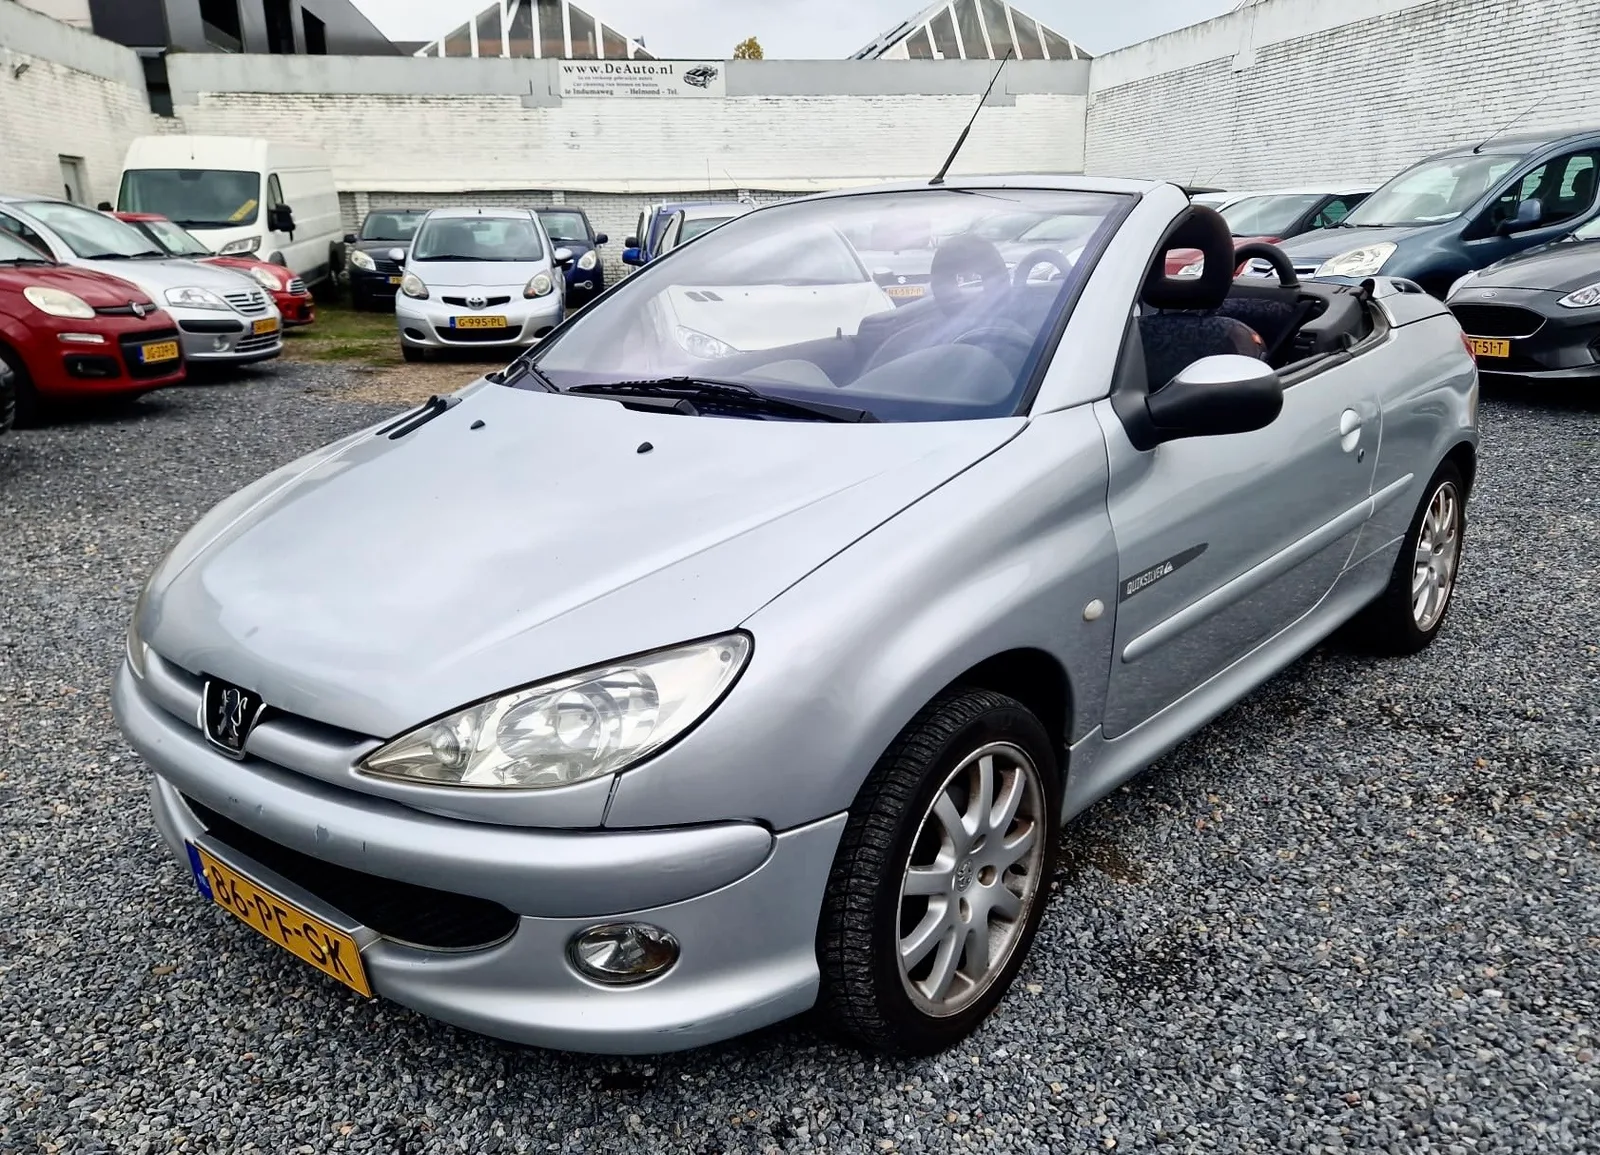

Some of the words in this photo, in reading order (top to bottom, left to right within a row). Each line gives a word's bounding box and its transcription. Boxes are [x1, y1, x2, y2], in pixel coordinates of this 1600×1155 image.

[563, 63, 674, 75] www.DeAuto.nl
[458, 318, 503, 327] G-995-PL
[1126, 565, 1164, 595] QUIKSILVER
[210, 865, 354, 983] 86-PF-SK
